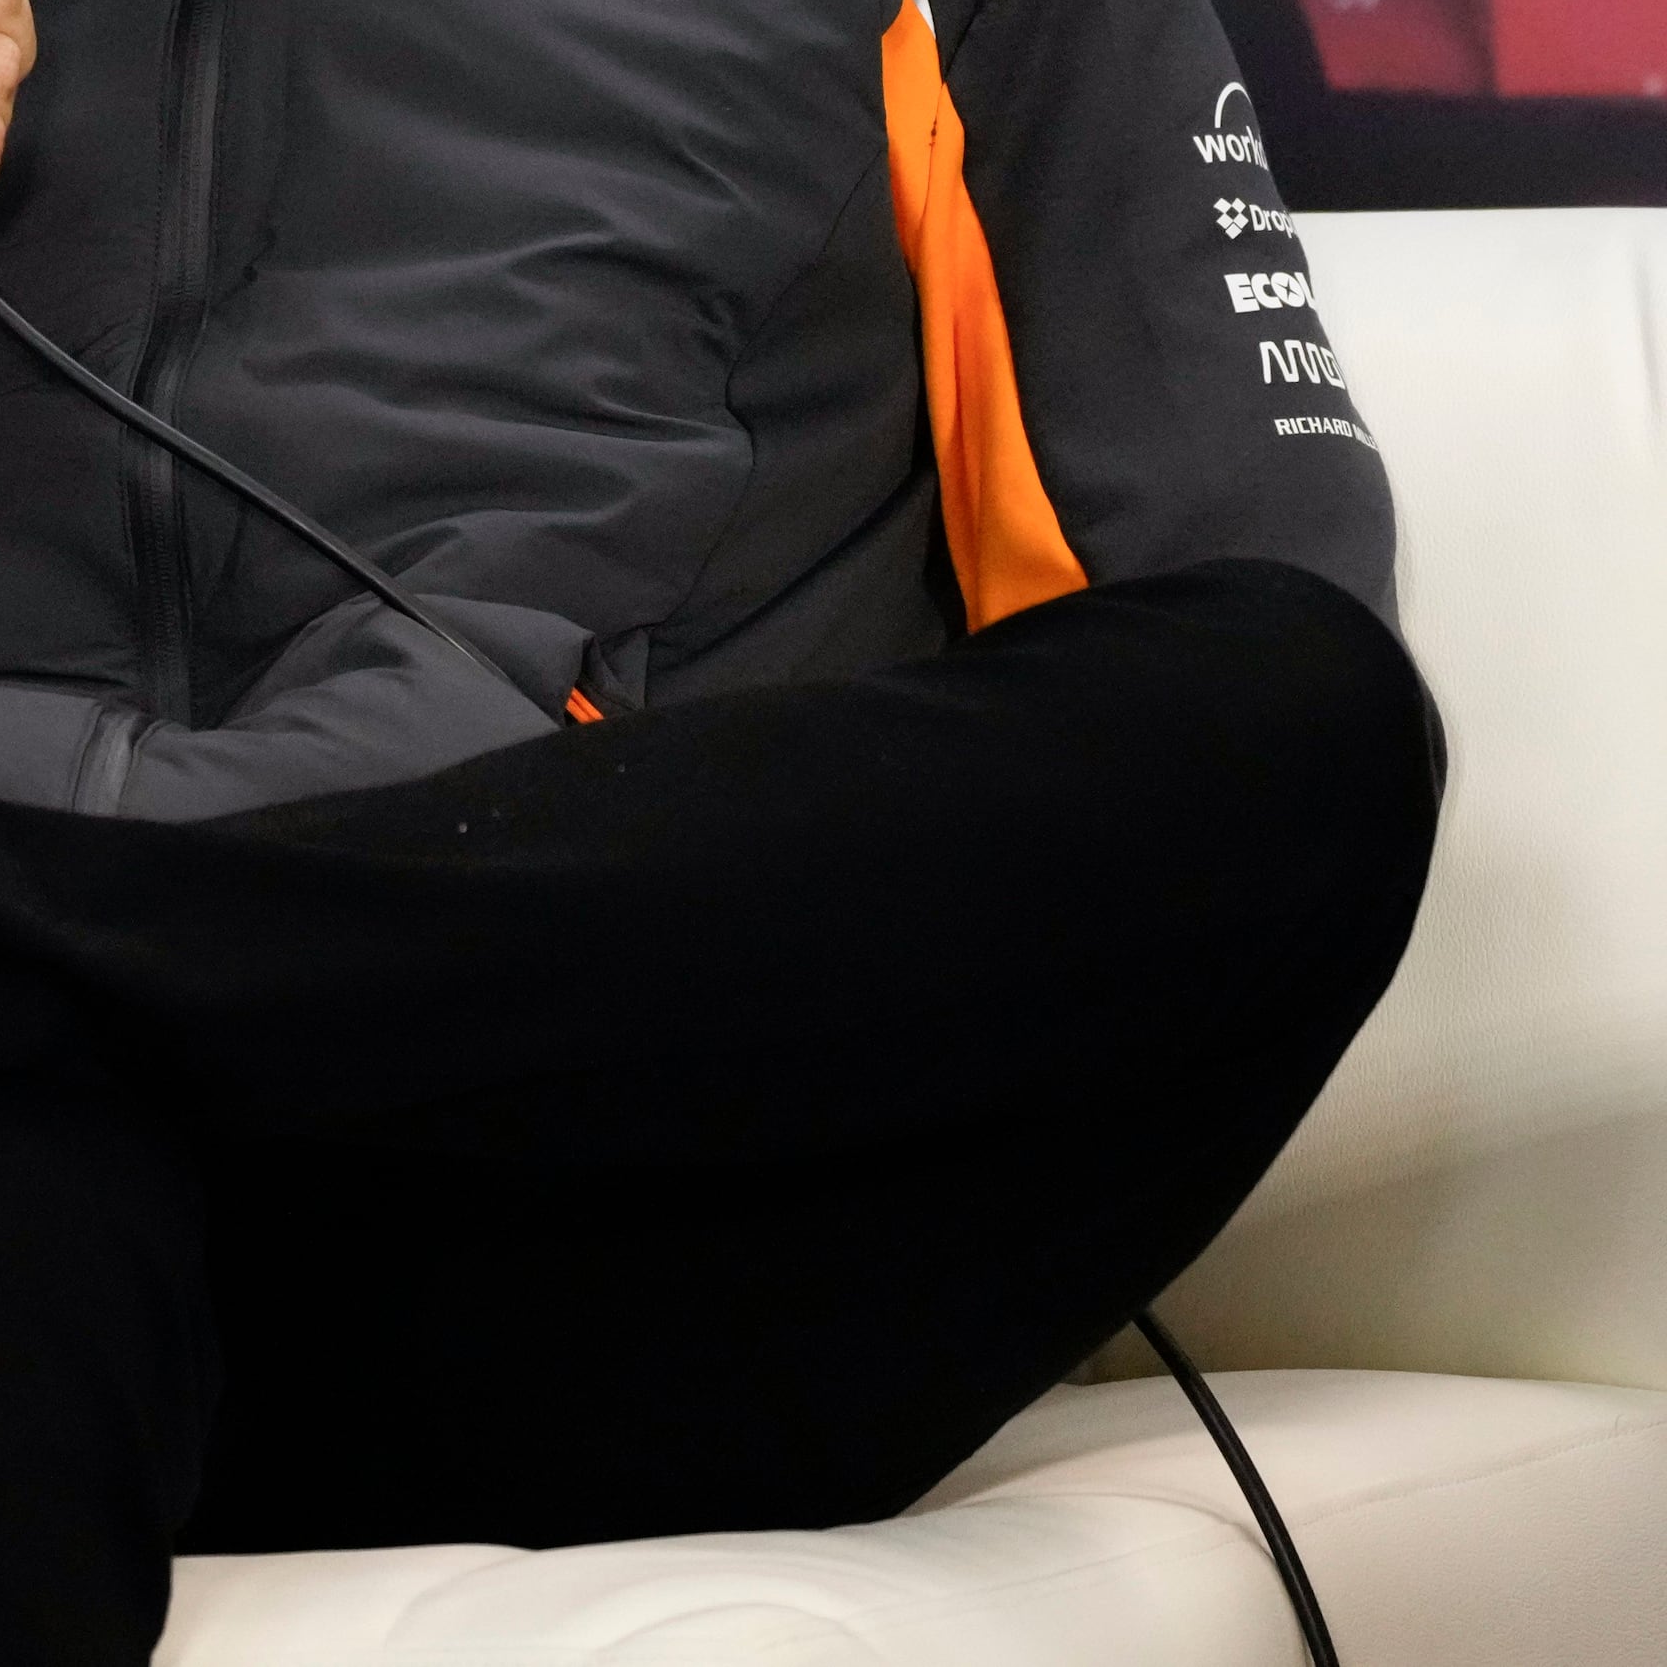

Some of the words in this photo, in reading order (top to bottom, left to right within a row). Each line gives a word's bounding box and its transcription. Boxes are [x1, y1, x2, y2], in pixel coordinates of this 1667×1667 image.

[1192, 125, 1269, 171] work
[1249, 204, 1297, 239] Drop
[1224, 272, 1318, 313] ECOL
[1274, 416, 1353, 438] RICHARD
